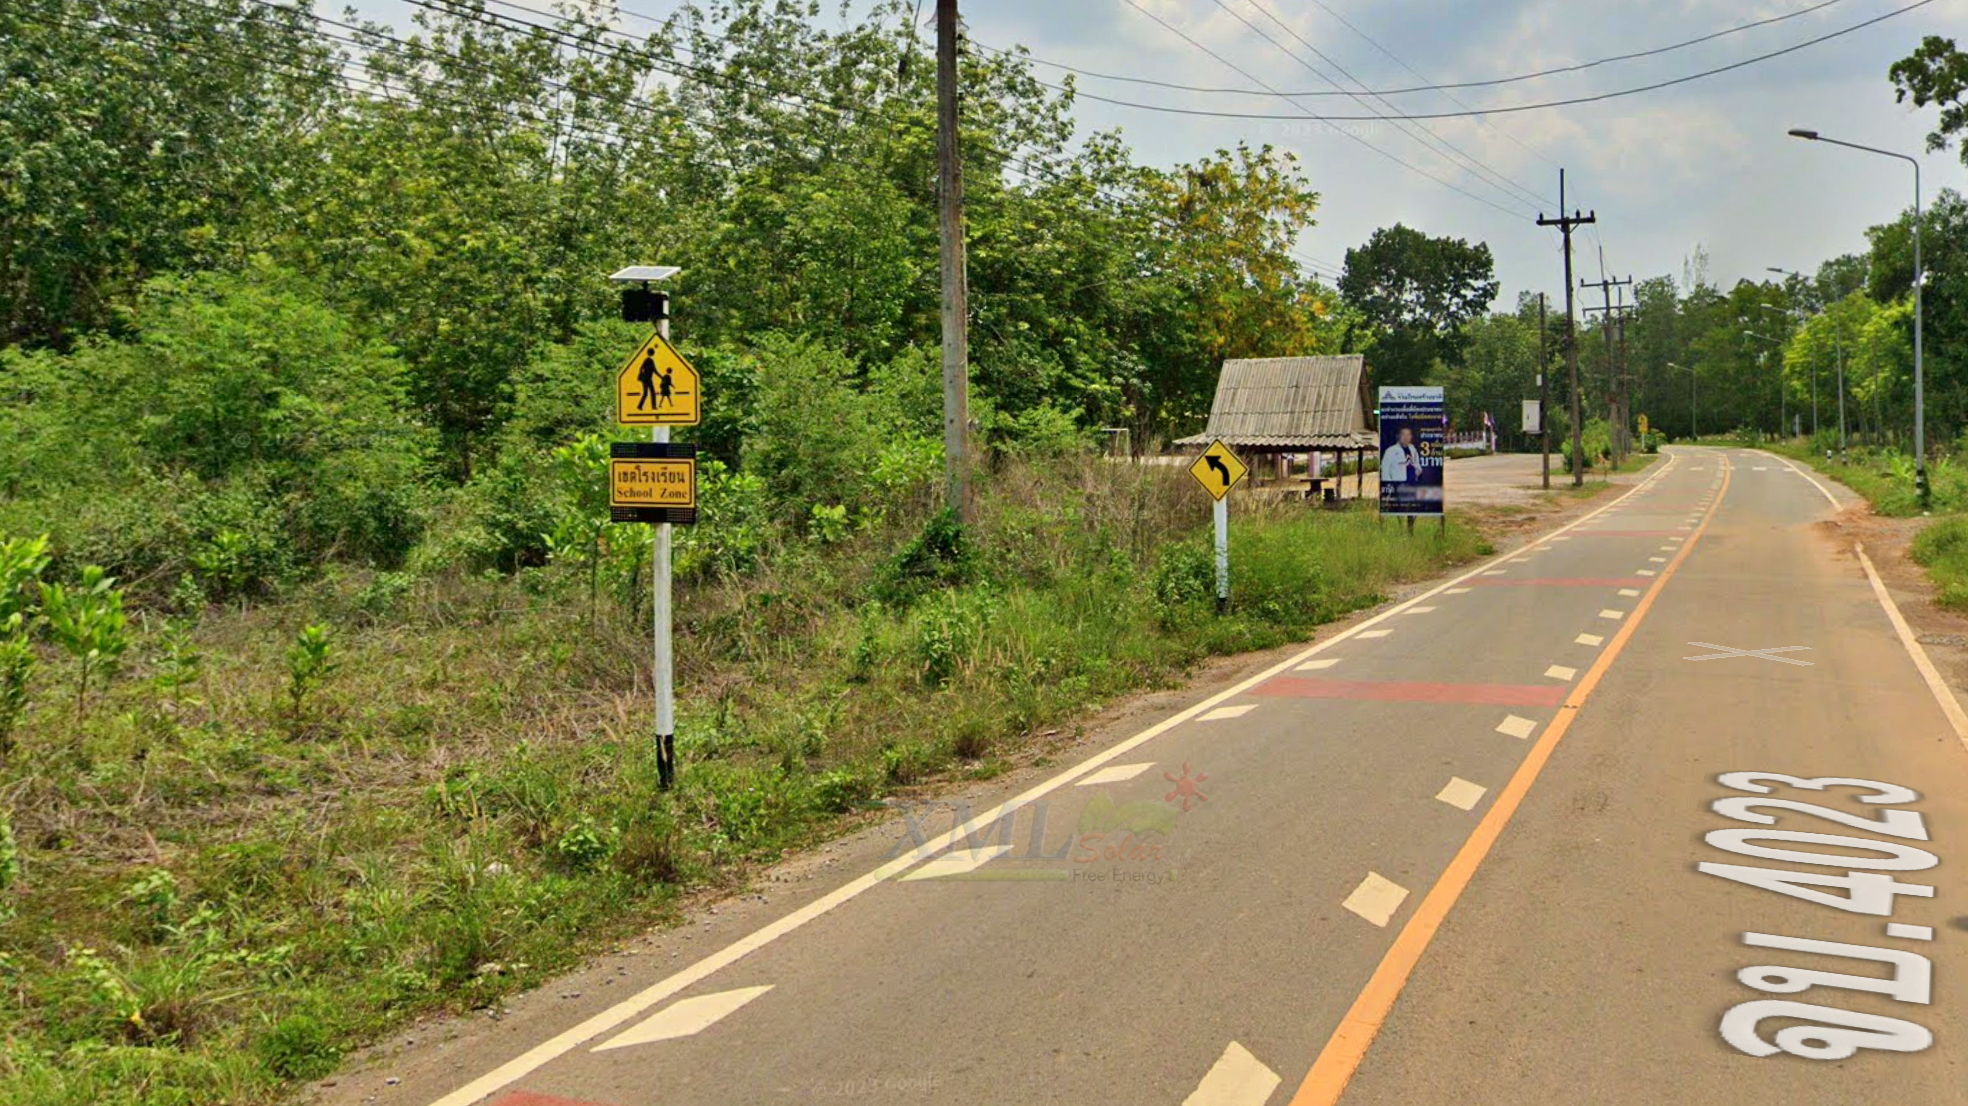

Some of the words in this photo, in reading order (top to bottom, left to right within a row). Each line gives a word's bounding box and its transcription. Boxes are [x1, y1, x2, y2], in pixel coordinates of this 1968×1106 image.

[617, 465, 686, 483] เขตโรงเรียน
[617, 487, 653, 498] School
[660, 488, 688, 499] Zone
